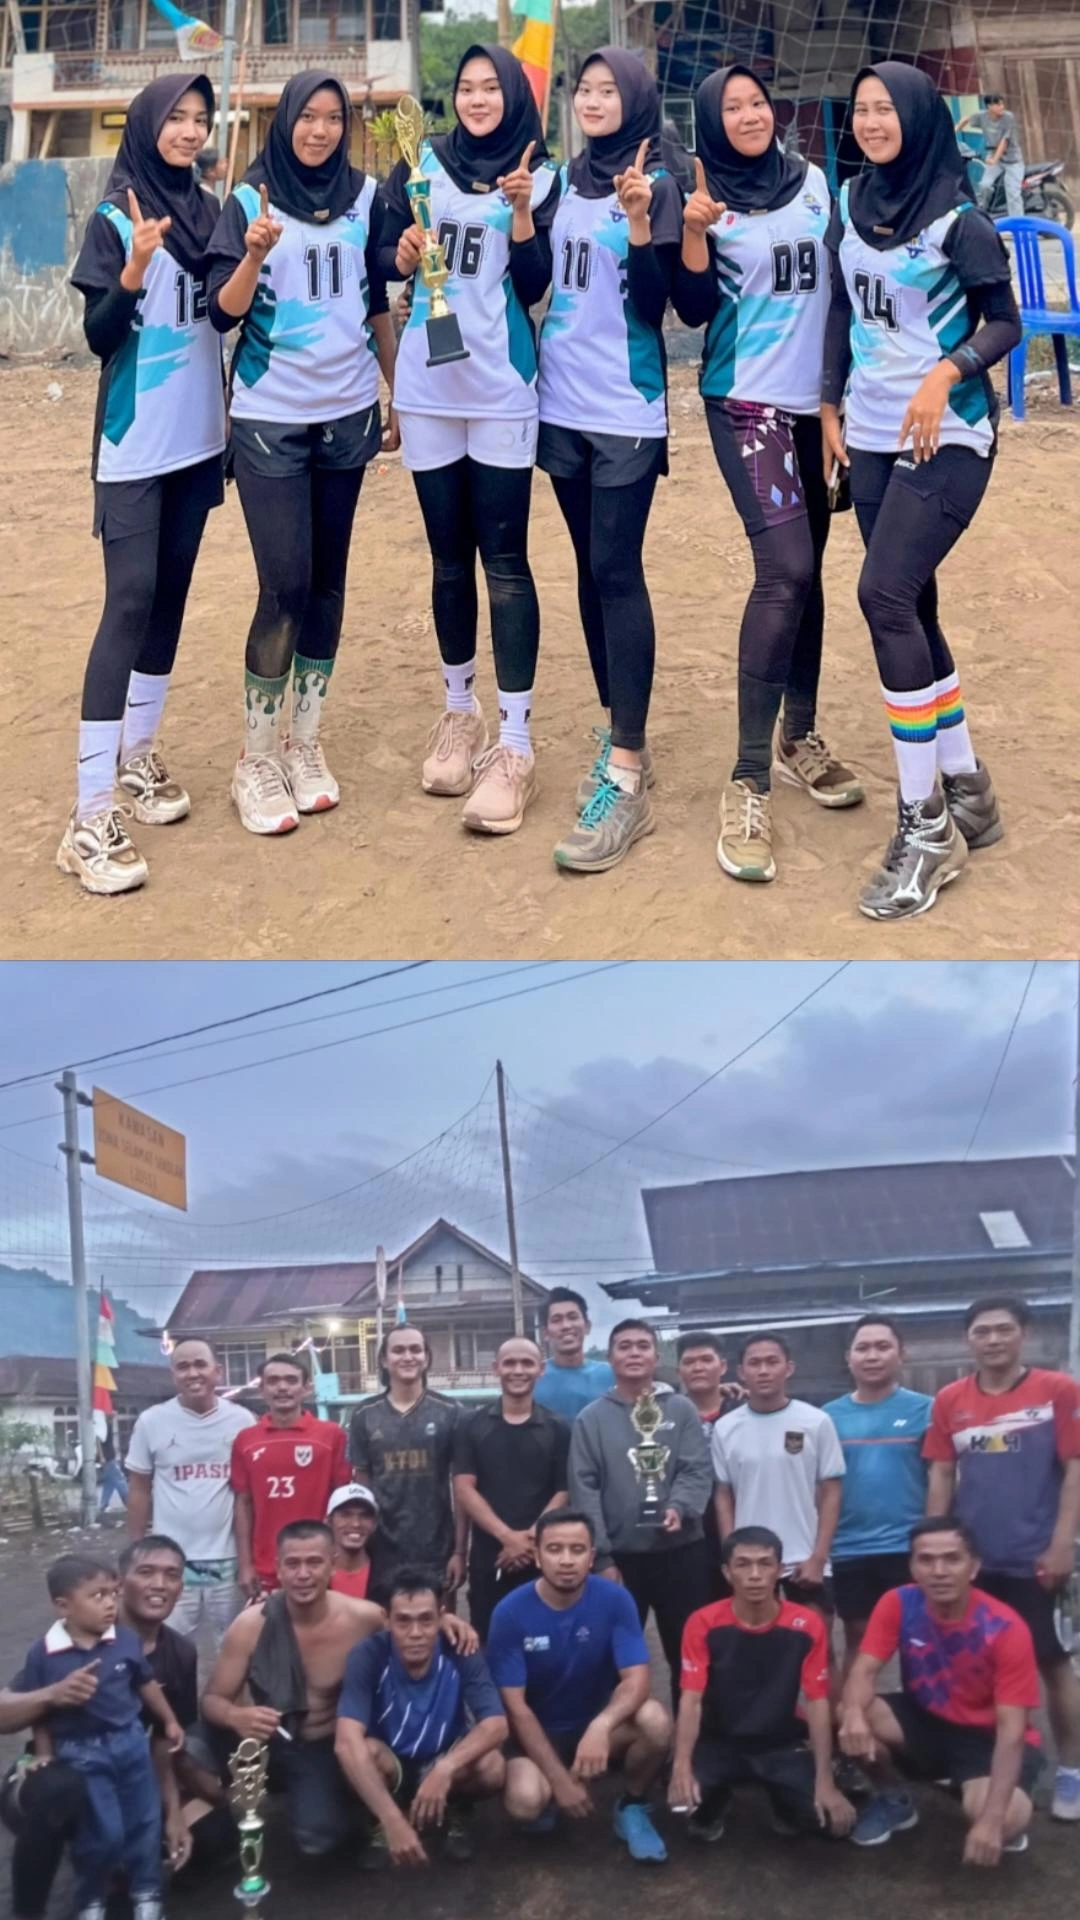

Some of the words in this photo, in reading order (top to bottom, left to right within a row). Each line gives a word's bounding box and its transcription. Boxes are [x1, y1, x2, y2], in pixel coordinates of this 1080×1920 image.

[304, 242, 342, 300] 11
[437, 218, 488, 279] 06
[562, 237, 592, 292] 10
[771, 237, 819, 295] 09
[175, 270, 208, 327] 12
[853, 269, 900, 332] 04
[267, 1476, 296, 1498] 23
